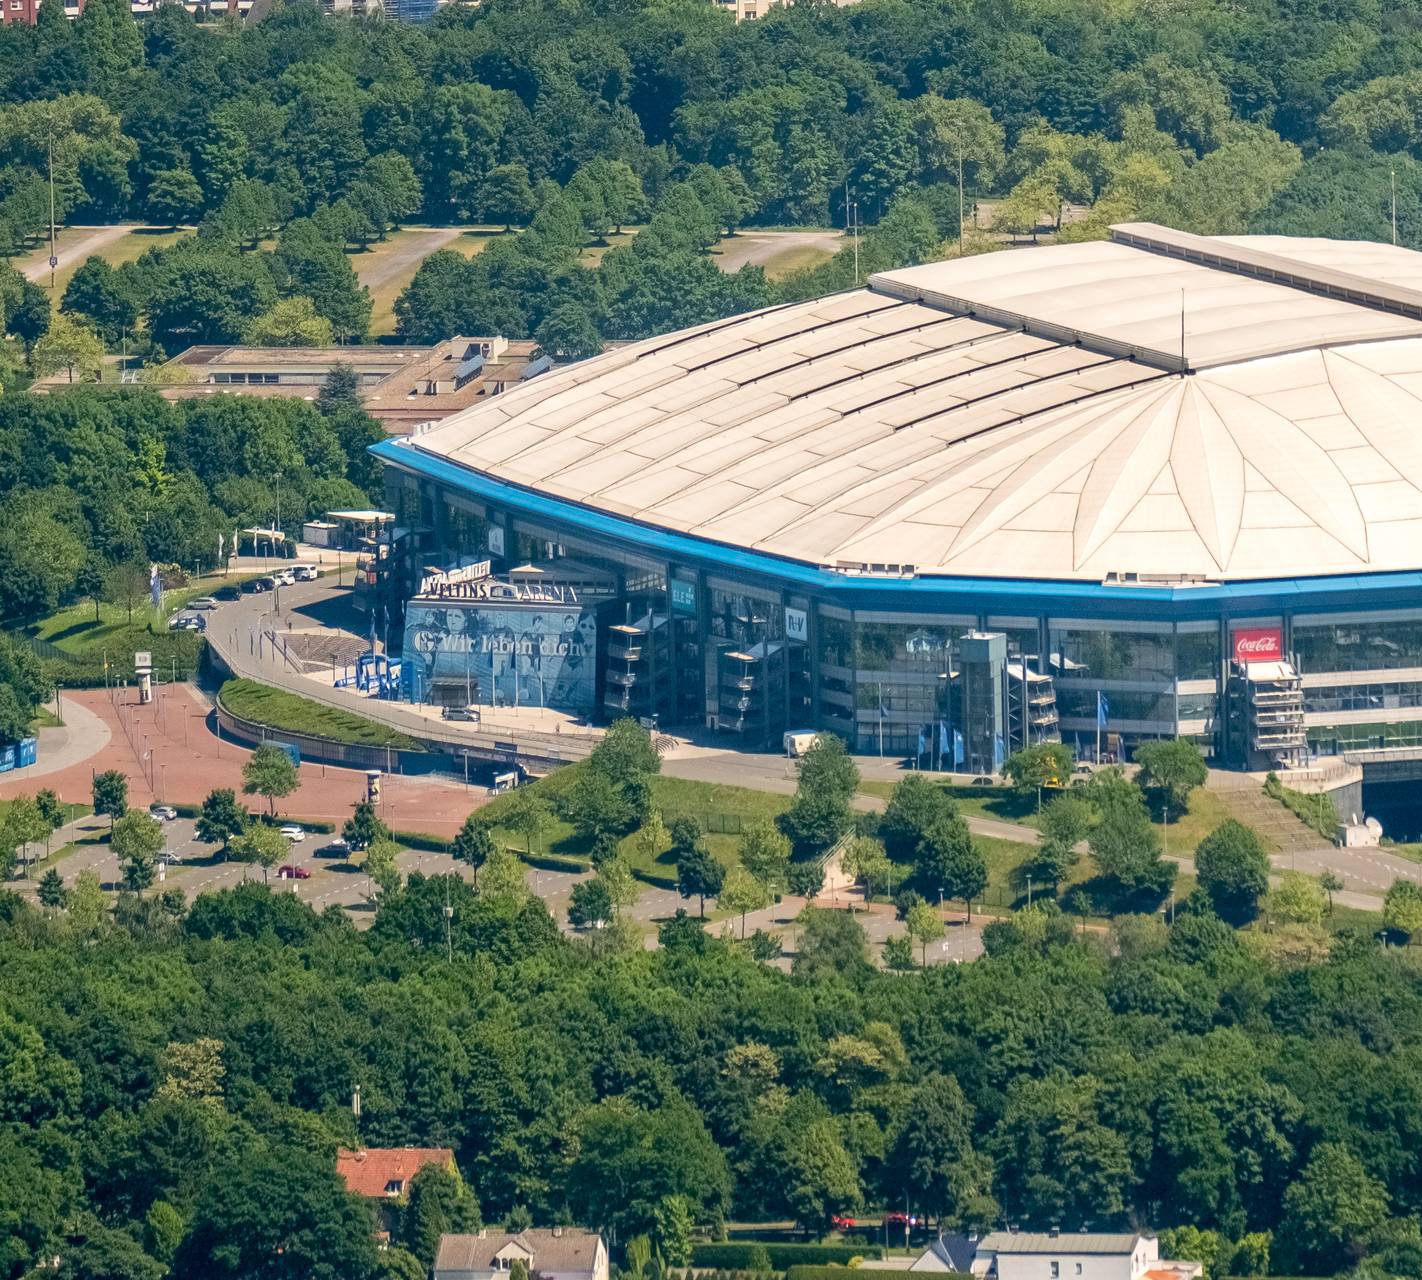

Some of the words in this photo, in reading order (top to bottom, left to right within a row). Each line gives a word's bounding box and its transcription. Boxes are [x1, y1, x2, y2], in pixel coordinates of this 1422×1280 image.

[429, 582, 488, 599] VELTINS
[520, 585, 578, 603] ARENA
[441, 633, 476, 653] Wir
[481, 634, 533, 655] leben
[539, 636, 581, 657] dich
